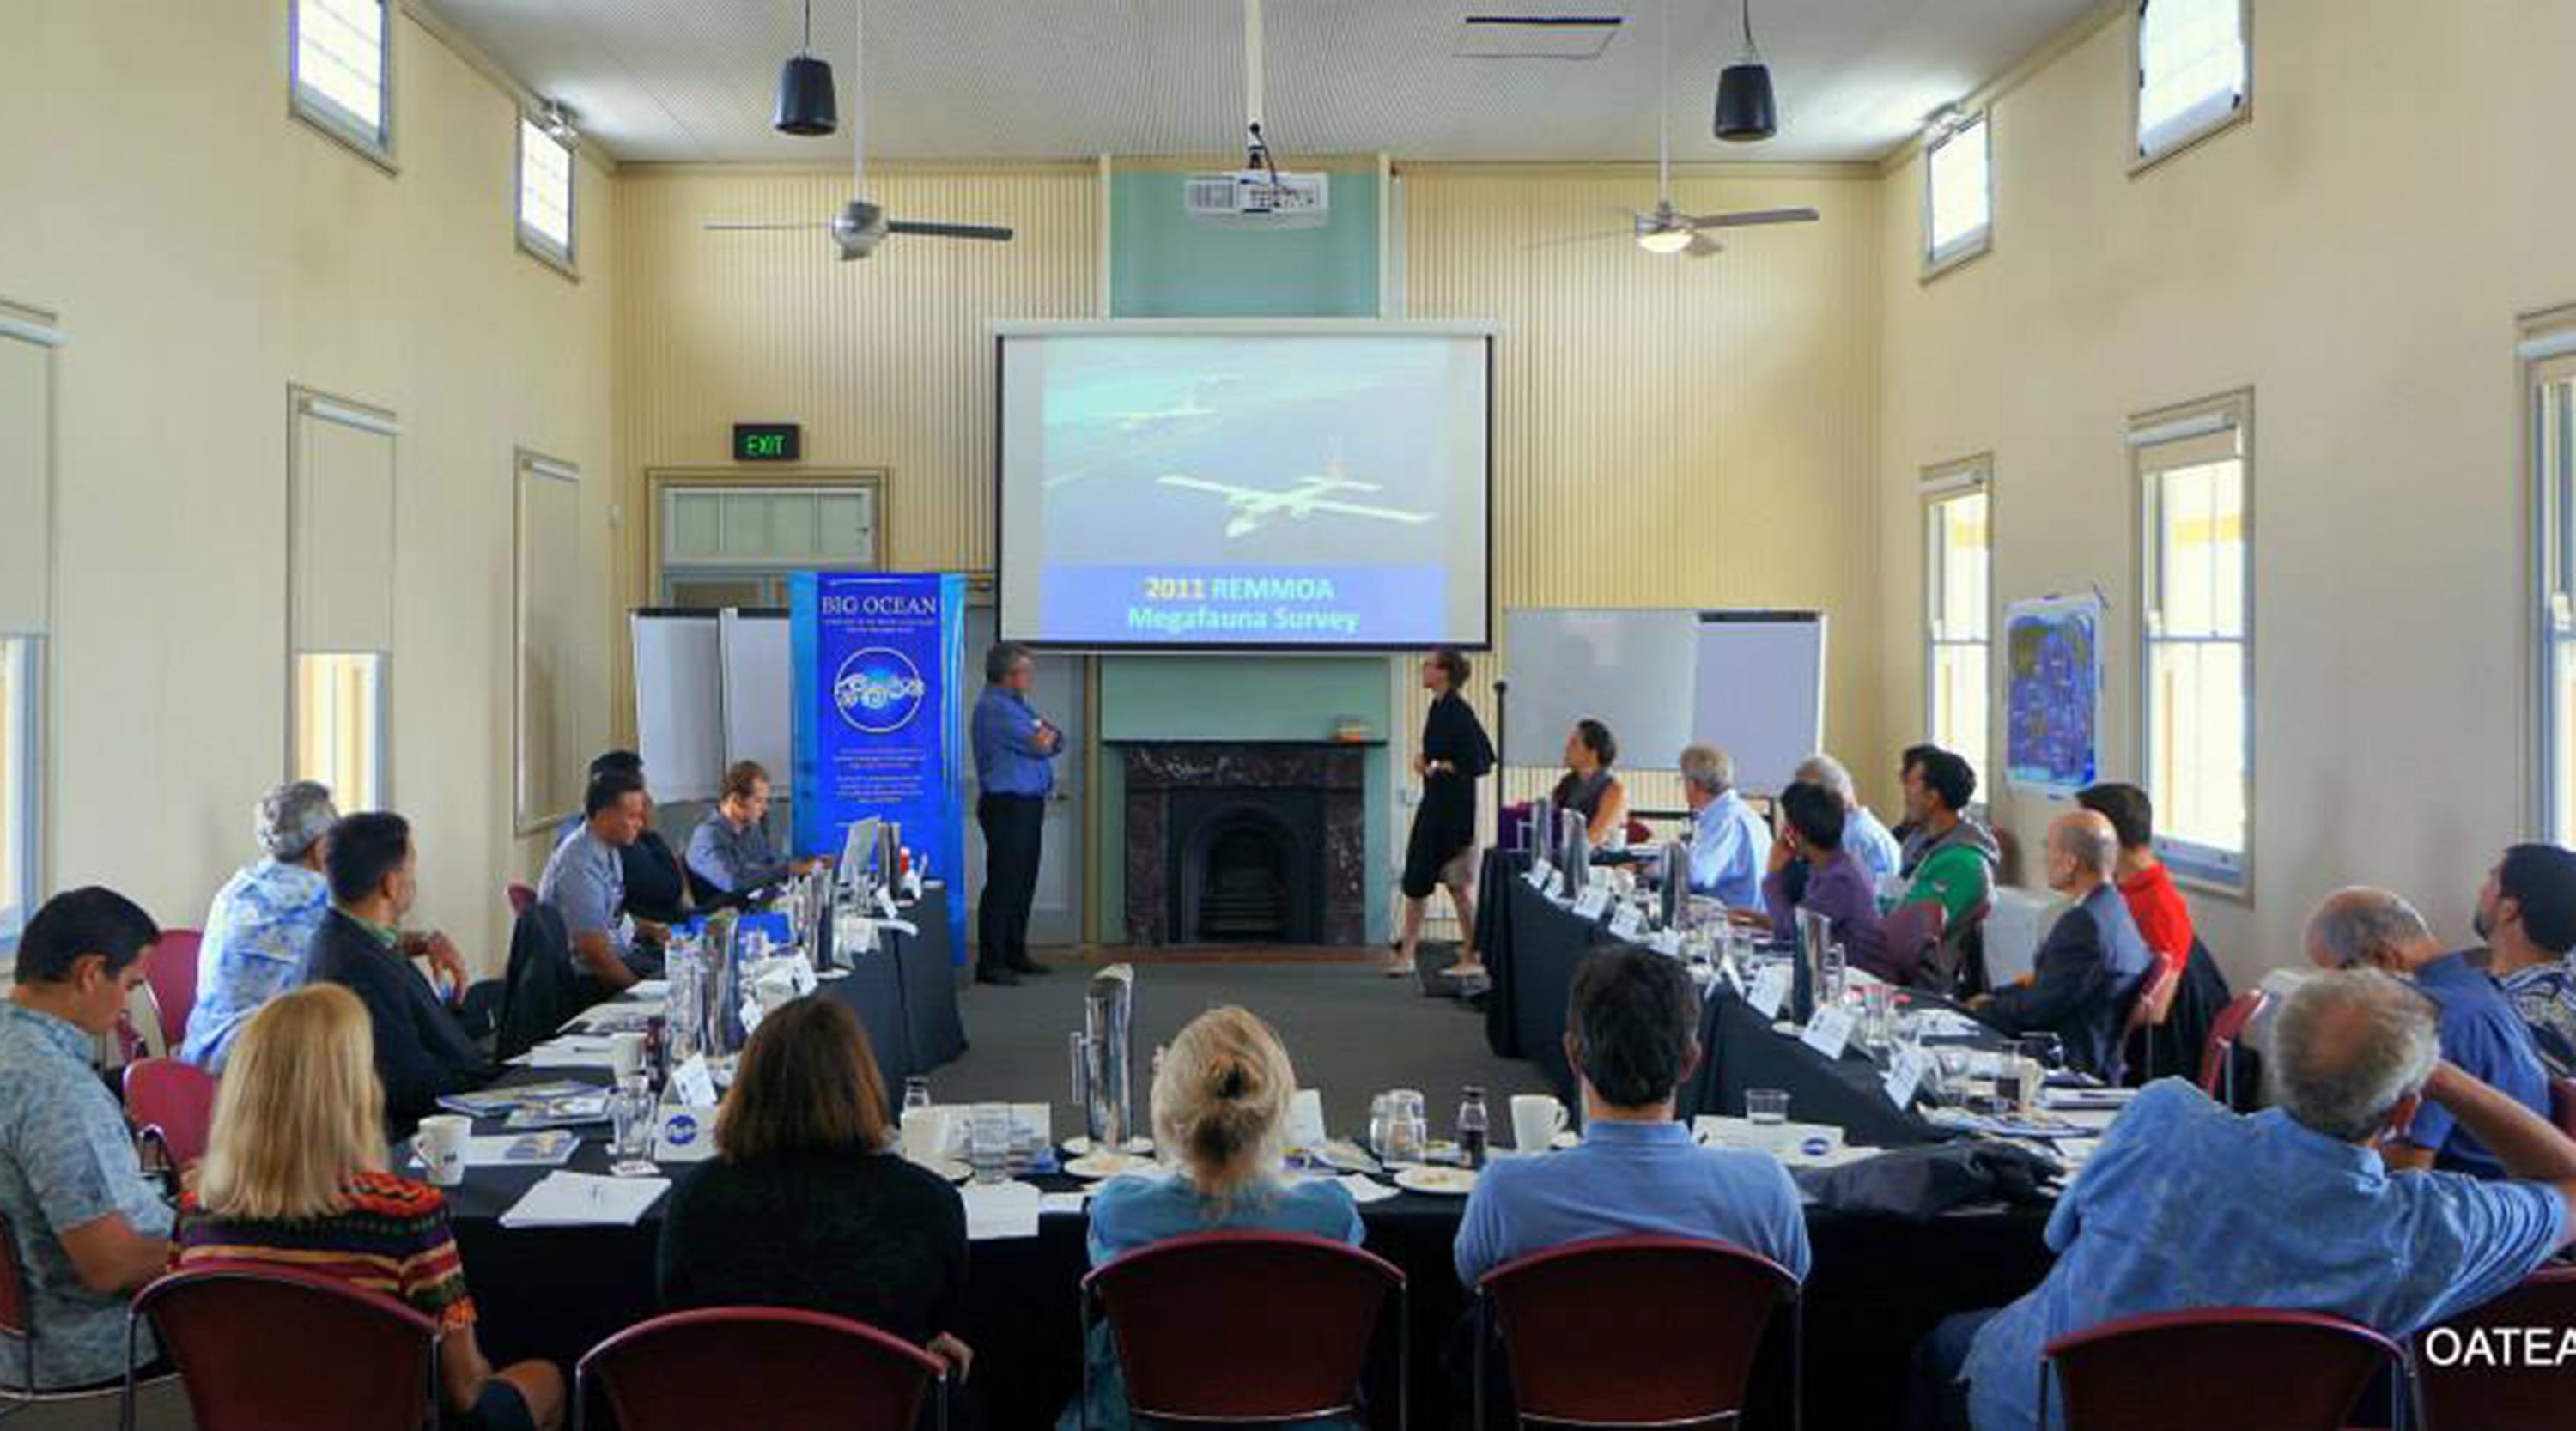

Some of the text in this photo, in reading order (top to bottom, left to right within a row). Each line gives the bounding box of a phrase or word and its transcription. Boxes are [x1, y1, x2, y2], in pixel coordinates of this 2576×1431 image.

[747, 434, 785, 457] EXIT
[1145, 575, 1335, 599] 2011 REMMOA
[822, 596, 937, 615] BIG OCEAN
[1129, 606, 1359, 634] Megafauna Survey
